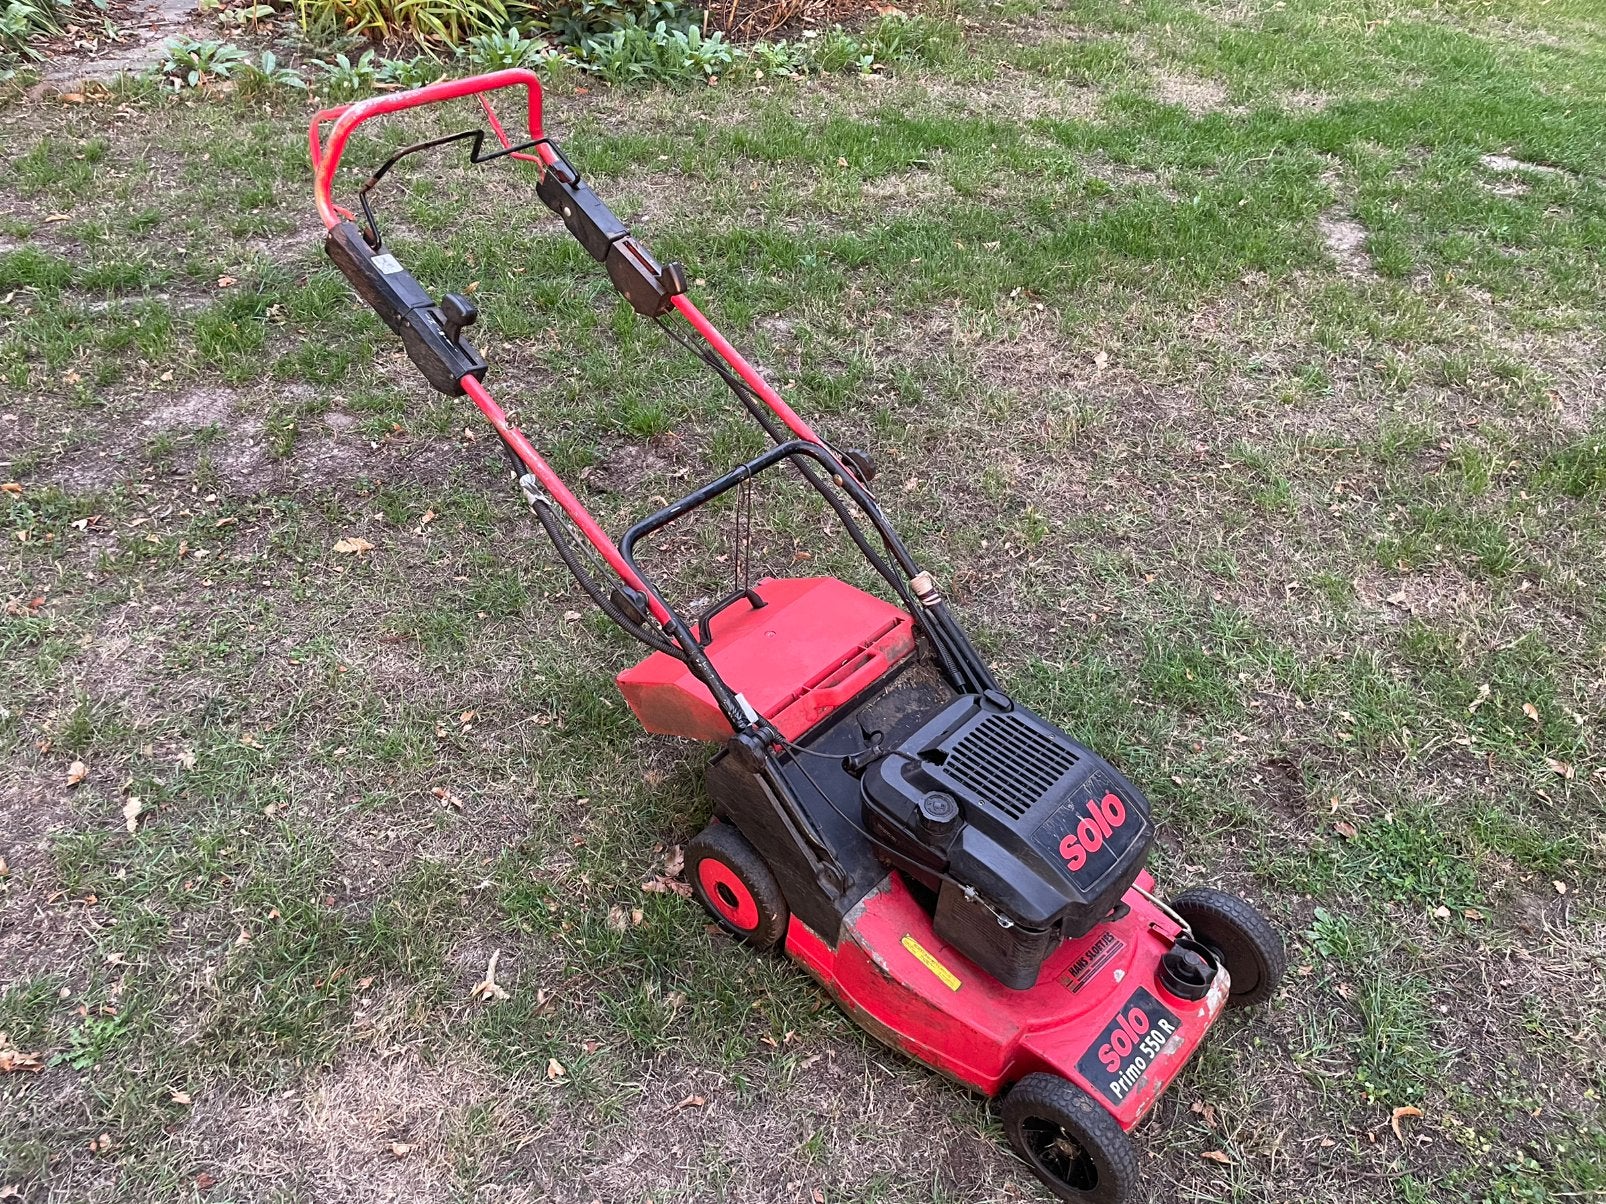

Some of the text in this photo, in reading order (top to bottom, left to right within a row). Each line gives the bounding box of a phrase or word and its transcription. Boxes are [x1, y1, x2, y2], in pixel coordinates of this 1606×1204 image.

[1060, 793, 1126, 872] solo
[1068, 956, 1089, 978] HANS
[1098, 1007, 1150, 1073] solo
[1109, 1018, 1176, 1099] Primo 550 R
